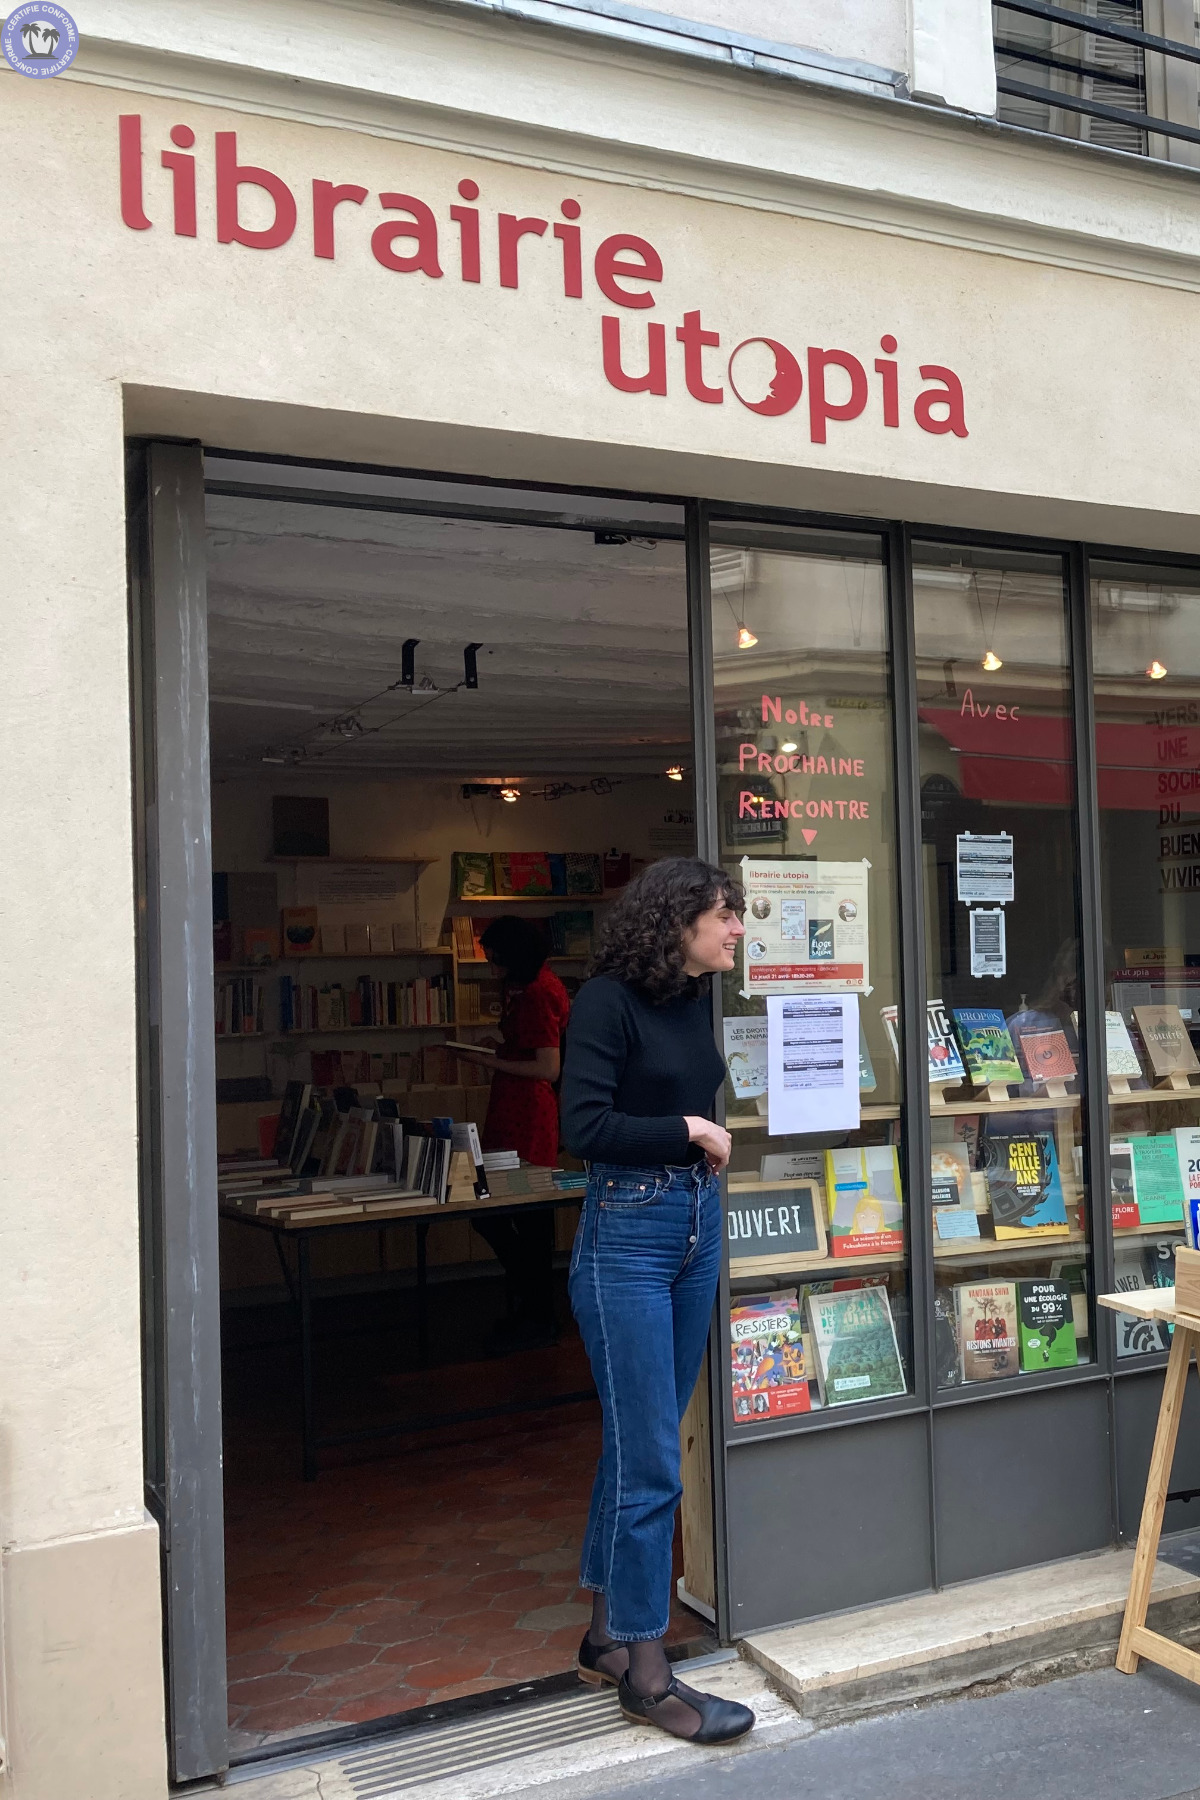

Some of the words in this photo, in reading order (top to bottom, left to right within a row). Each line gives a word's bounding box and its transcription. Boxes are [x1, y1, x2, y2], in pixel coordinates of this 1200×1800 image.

[119, 113, 664, 309] librairie
[600, 309, 969, 443] utopia
[960, 688, 1020, 721] Avec
[1153, 703, 1198, 729] VERS
[1157, 736, 1188, 761] UNE
[738, 743, 864, 777] PROCHAINE
[738, 790, 870, 820] RENCONTRE
[1159, 802, 1181, 825] DU
[749, 870, 780, 879] librairie
[782, 871, 809, 880] utopia
[1149, 1031, 1185, 1041] SOBRIÉTÉS
[1008, 1143, 1037, 1157] CENT
[1008, 1156, 1041, 1171] MILLE
[1016, 1170, 1040, 1185] ANS
[1188, 1174, 1197, 1182] LA
[727, 1205, 801, 1240] OUVERT
[968, 1287, 994, 1298] VANDANA
[994, 1287, 1009, 1296] SHIVA
[1033, 1285, 1055, 1294] POUR
[820, 1305, 836, 1316] UNE
[966, 1339, 992, 1350] RESTONS
[992, 1337, 1016, 1348] VIVANTES
